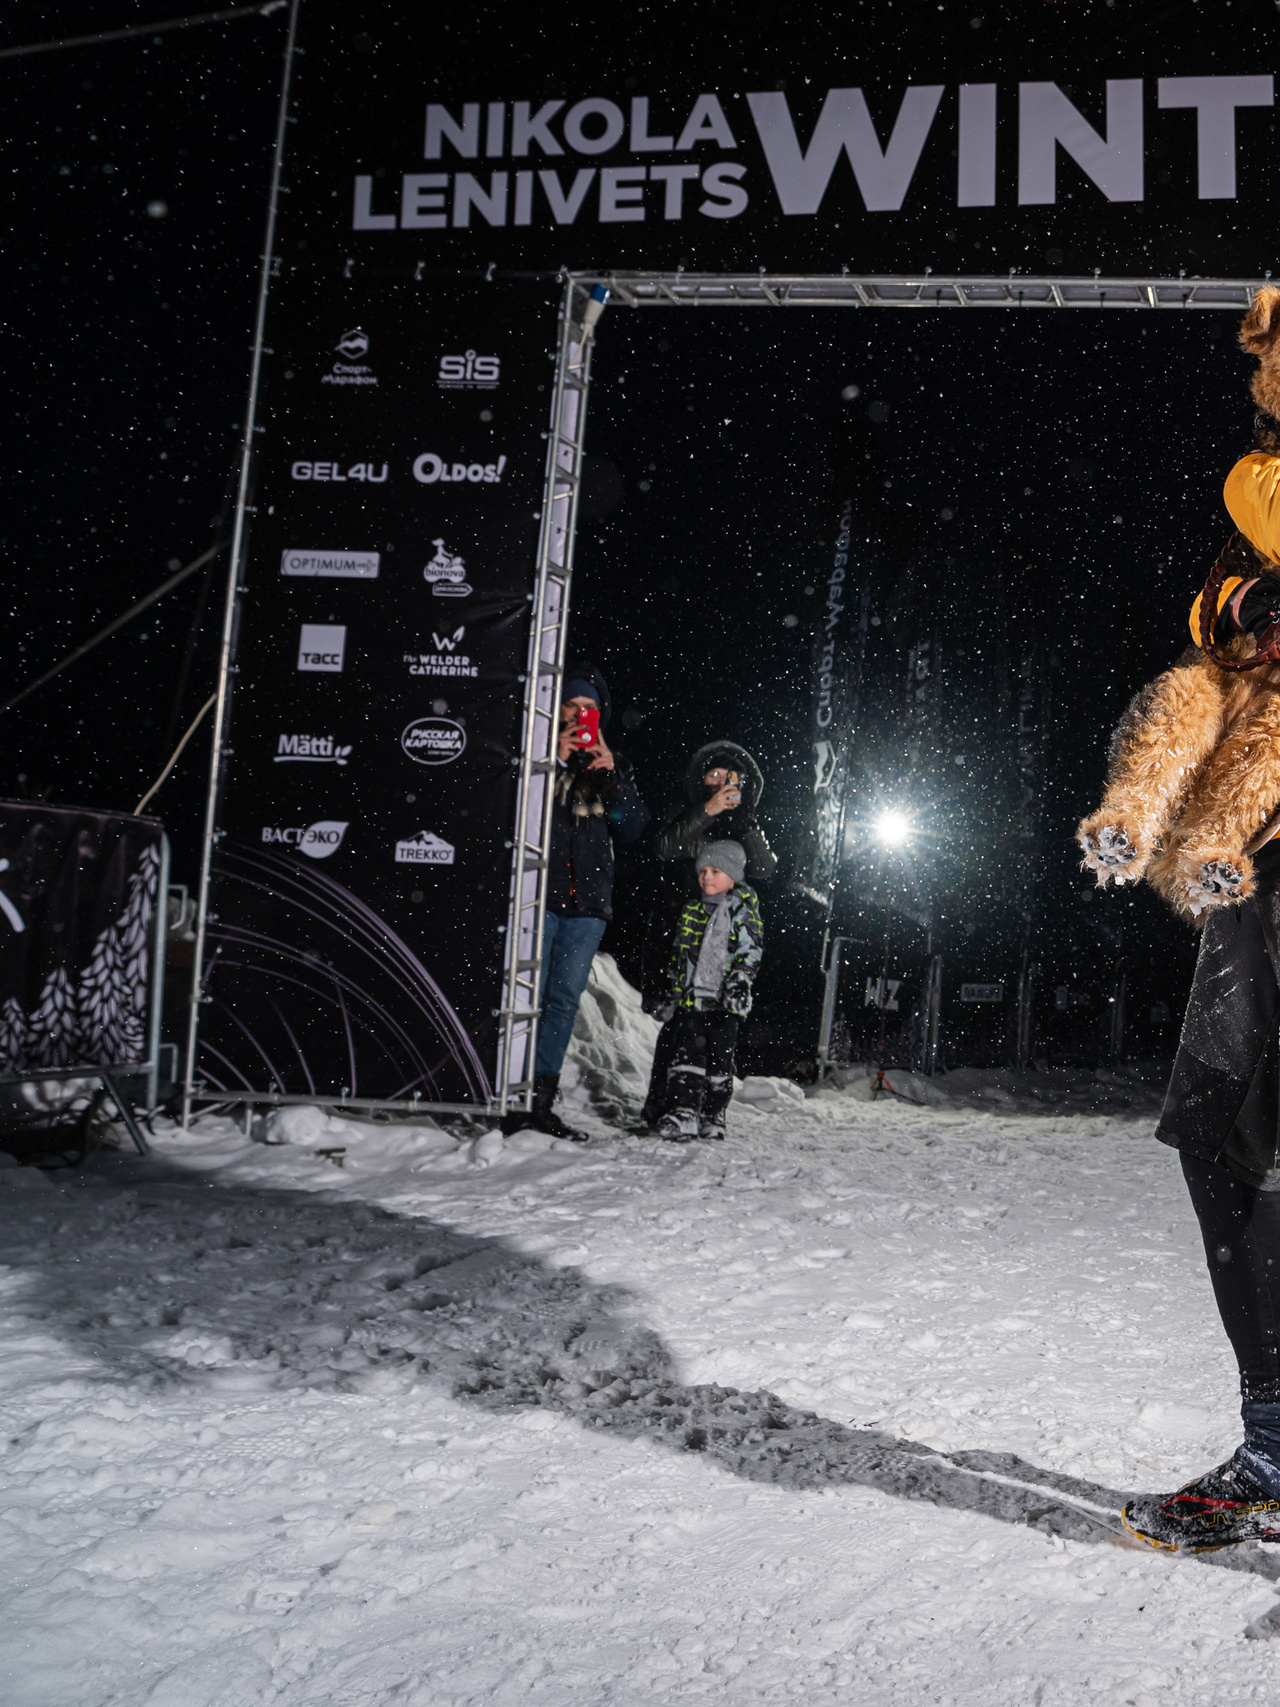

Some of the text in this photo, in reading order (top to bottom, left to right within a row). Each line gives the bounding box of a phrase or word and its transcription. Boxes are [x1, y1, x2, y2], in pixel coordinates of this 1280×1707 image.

[424, 92, 737, 160] NIKOLA
[352, 162, 749, 231] LENIVETS
[321, 374, 377, 386] Марафон
[291, 461, 388, 482] GEL4U
[290, 557, 356, 571] OPTIMUM
[425, 567, 464, 578] bionova
[420, 655, 470, 666] WELDER
[409, 665, 478, 678] CATHERINE
[411, 729, 460, 740] РУССКАЯ
[277, 734, 334, 756] Mätti
[405, 738, 461, 749] КАРТОШКА
